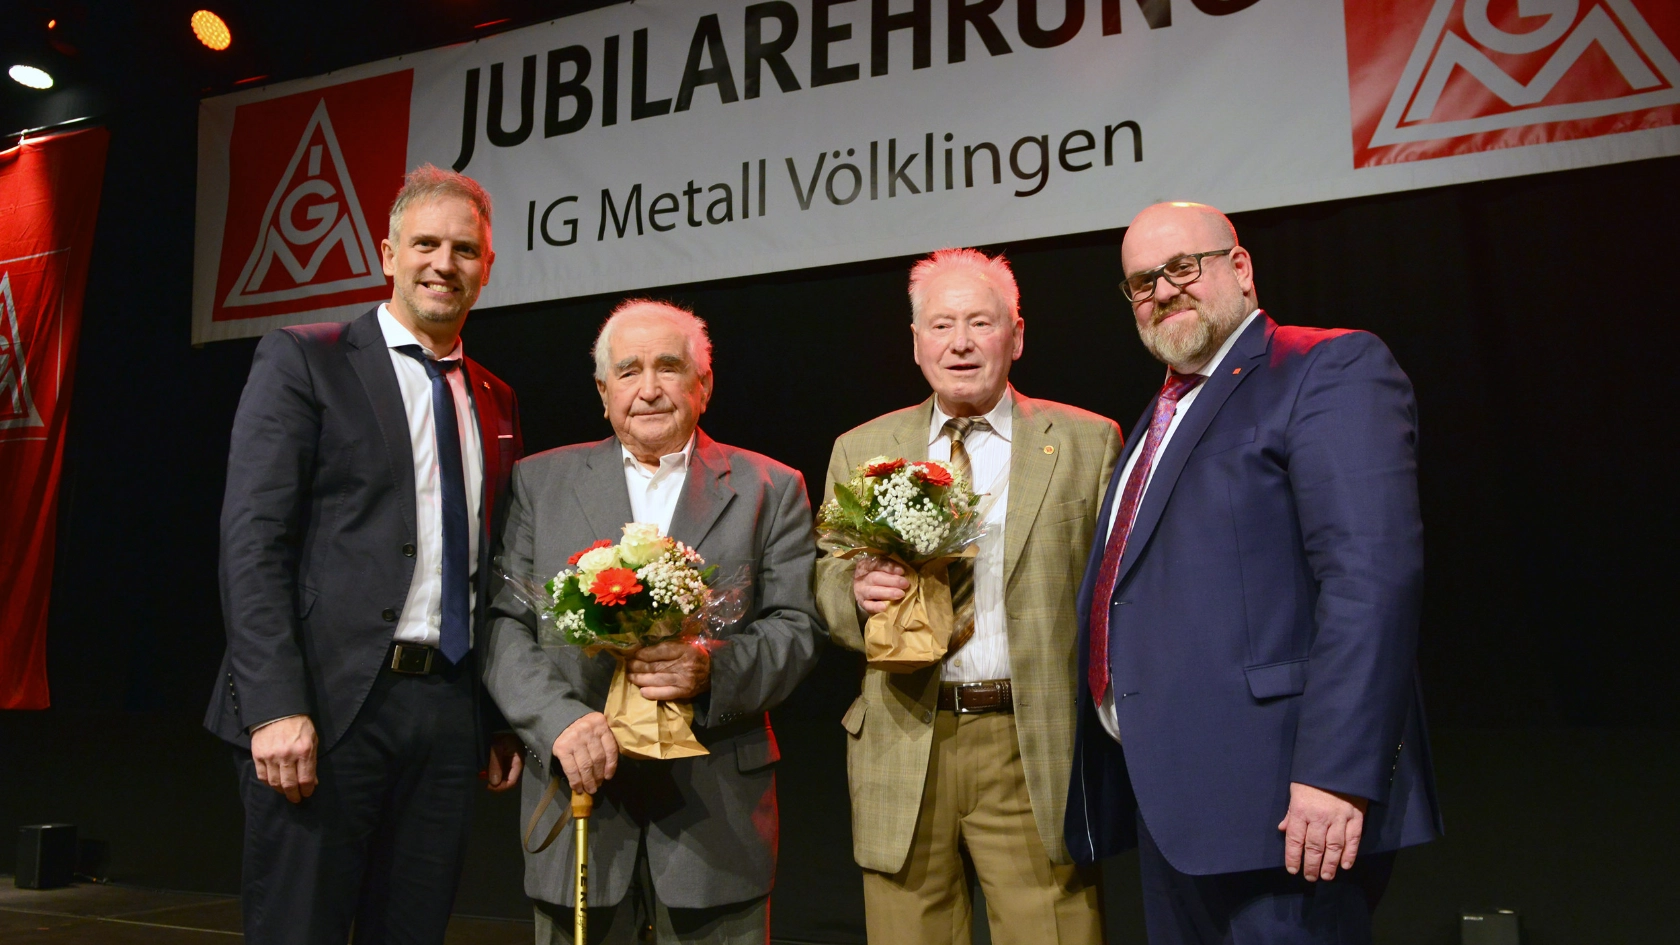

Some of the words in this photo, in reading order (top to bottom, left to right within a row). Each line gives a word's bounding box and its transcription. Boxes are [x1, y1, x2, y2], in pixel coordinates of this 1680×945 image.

[452, 0, 1261, 173] JUBILAREHR
[527, 195, 579, 251] IG
[597, 158, 767, 242] Metall
[785, 119, 1144, 211] Völklingen
